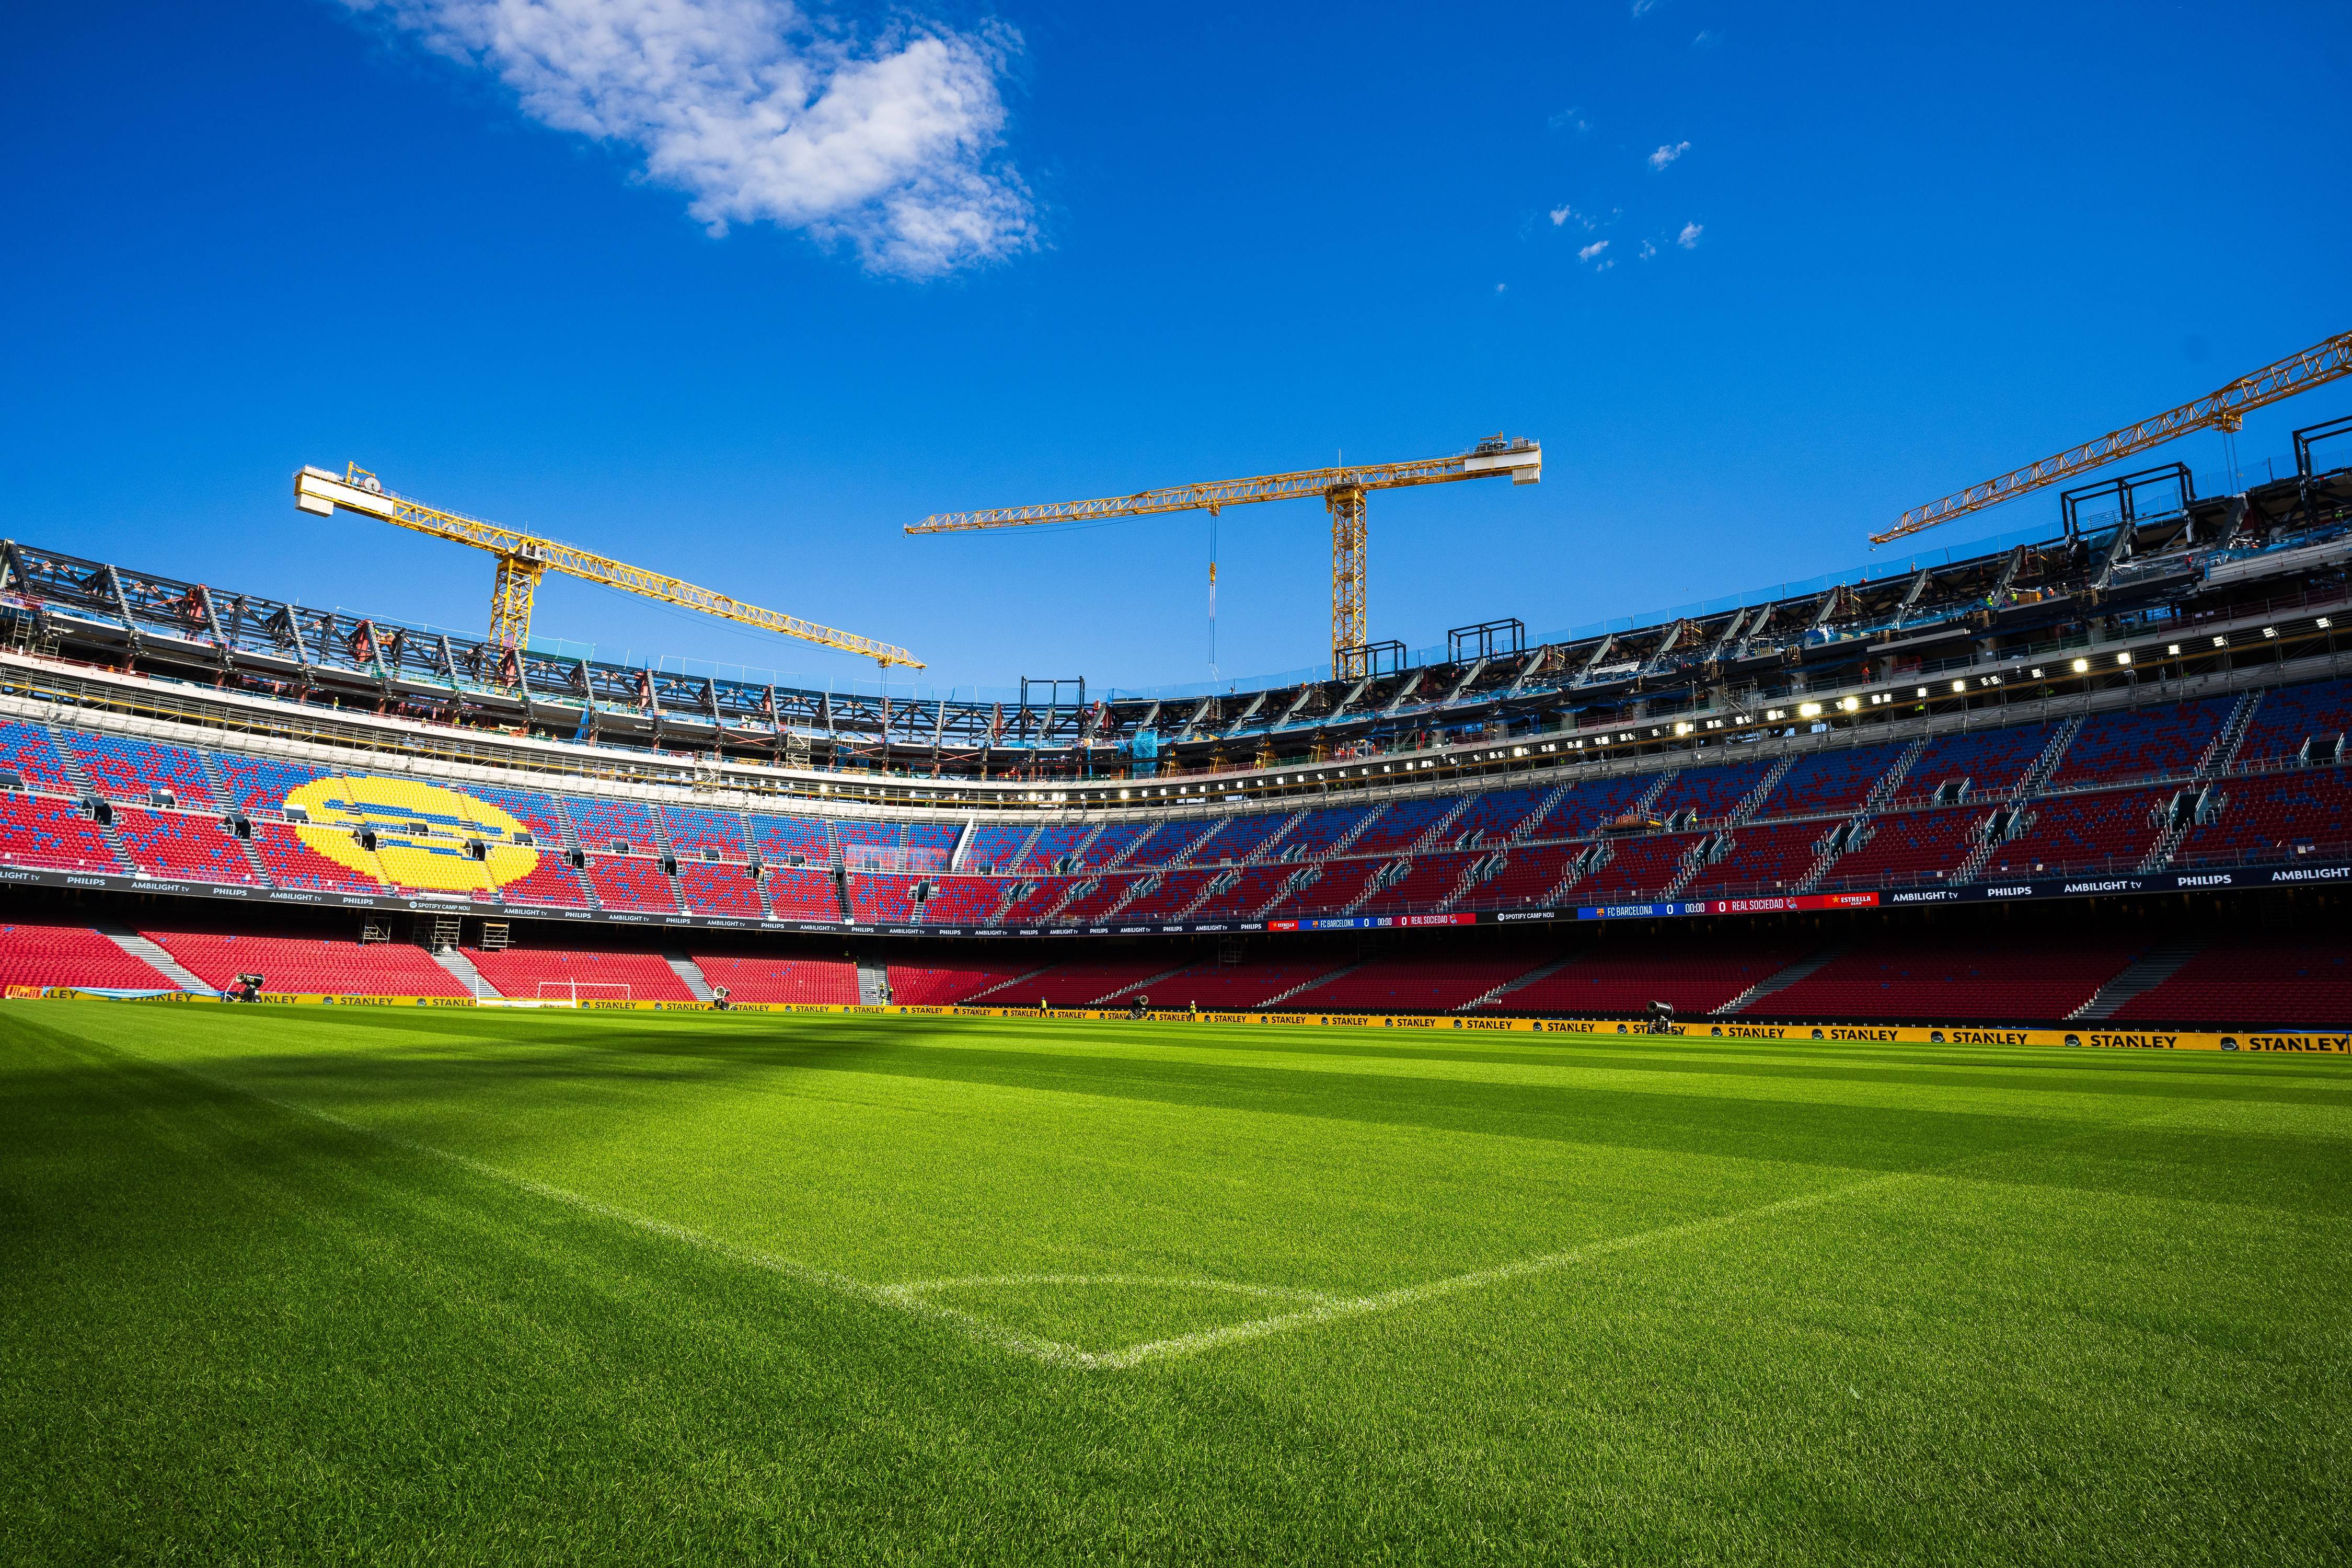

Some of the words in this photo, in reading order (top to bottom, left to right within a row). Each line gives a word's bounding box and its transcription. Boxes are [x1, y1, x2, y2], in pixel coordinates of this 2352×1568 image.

[0, 871, 29, 881] LIGHT
[2272, 868, 2350, 880] AMBILIGHT
[67, 877, 105, 885] PHILIPS
[2178, 875, 2231, 885] PHILIPS
[132, 882, 179, 891] AMBILIGHT
[1988, 886, 2032, 896] PHILIPS
[2065, 881, 2127, 893] AMBILIGHT
[270, 892, 312, 901] AMBILIGHT
[1893, 892, 1946, 901] AMBILIGHT
[1617, 906, 1652, 916] BARCELONA
[1667, 905, 1673, 914] 0
[1686, 903, 1705, 913] 00:00
[1719, 902, 1726, 912] 0
[1732, 901, 1748, 910] REAL
[1750, 900, 1783, 910] SOCIEDAD
[1364, 918, 1369, 927] 0
[1377, 917, 1392, 926] 00:00
[1411, 916, 1423, 925] REAL
[1397, 1019, 1435, 1027] STANLEY
[1467, 1020, 1512, 1029] STANLEY
[1548, 1022, 1594, 1032] STANLEY
[1729, 1027, 1785, 1037] STANLEY
[1831, 1029, 1898, 1041] STANLEY
[1953, 1032, 2028, 1044] STANLEY
[2090, 1035, 2177, 1048] STANLEY
[2250, 1037, 2349, 1051] STANLEY
